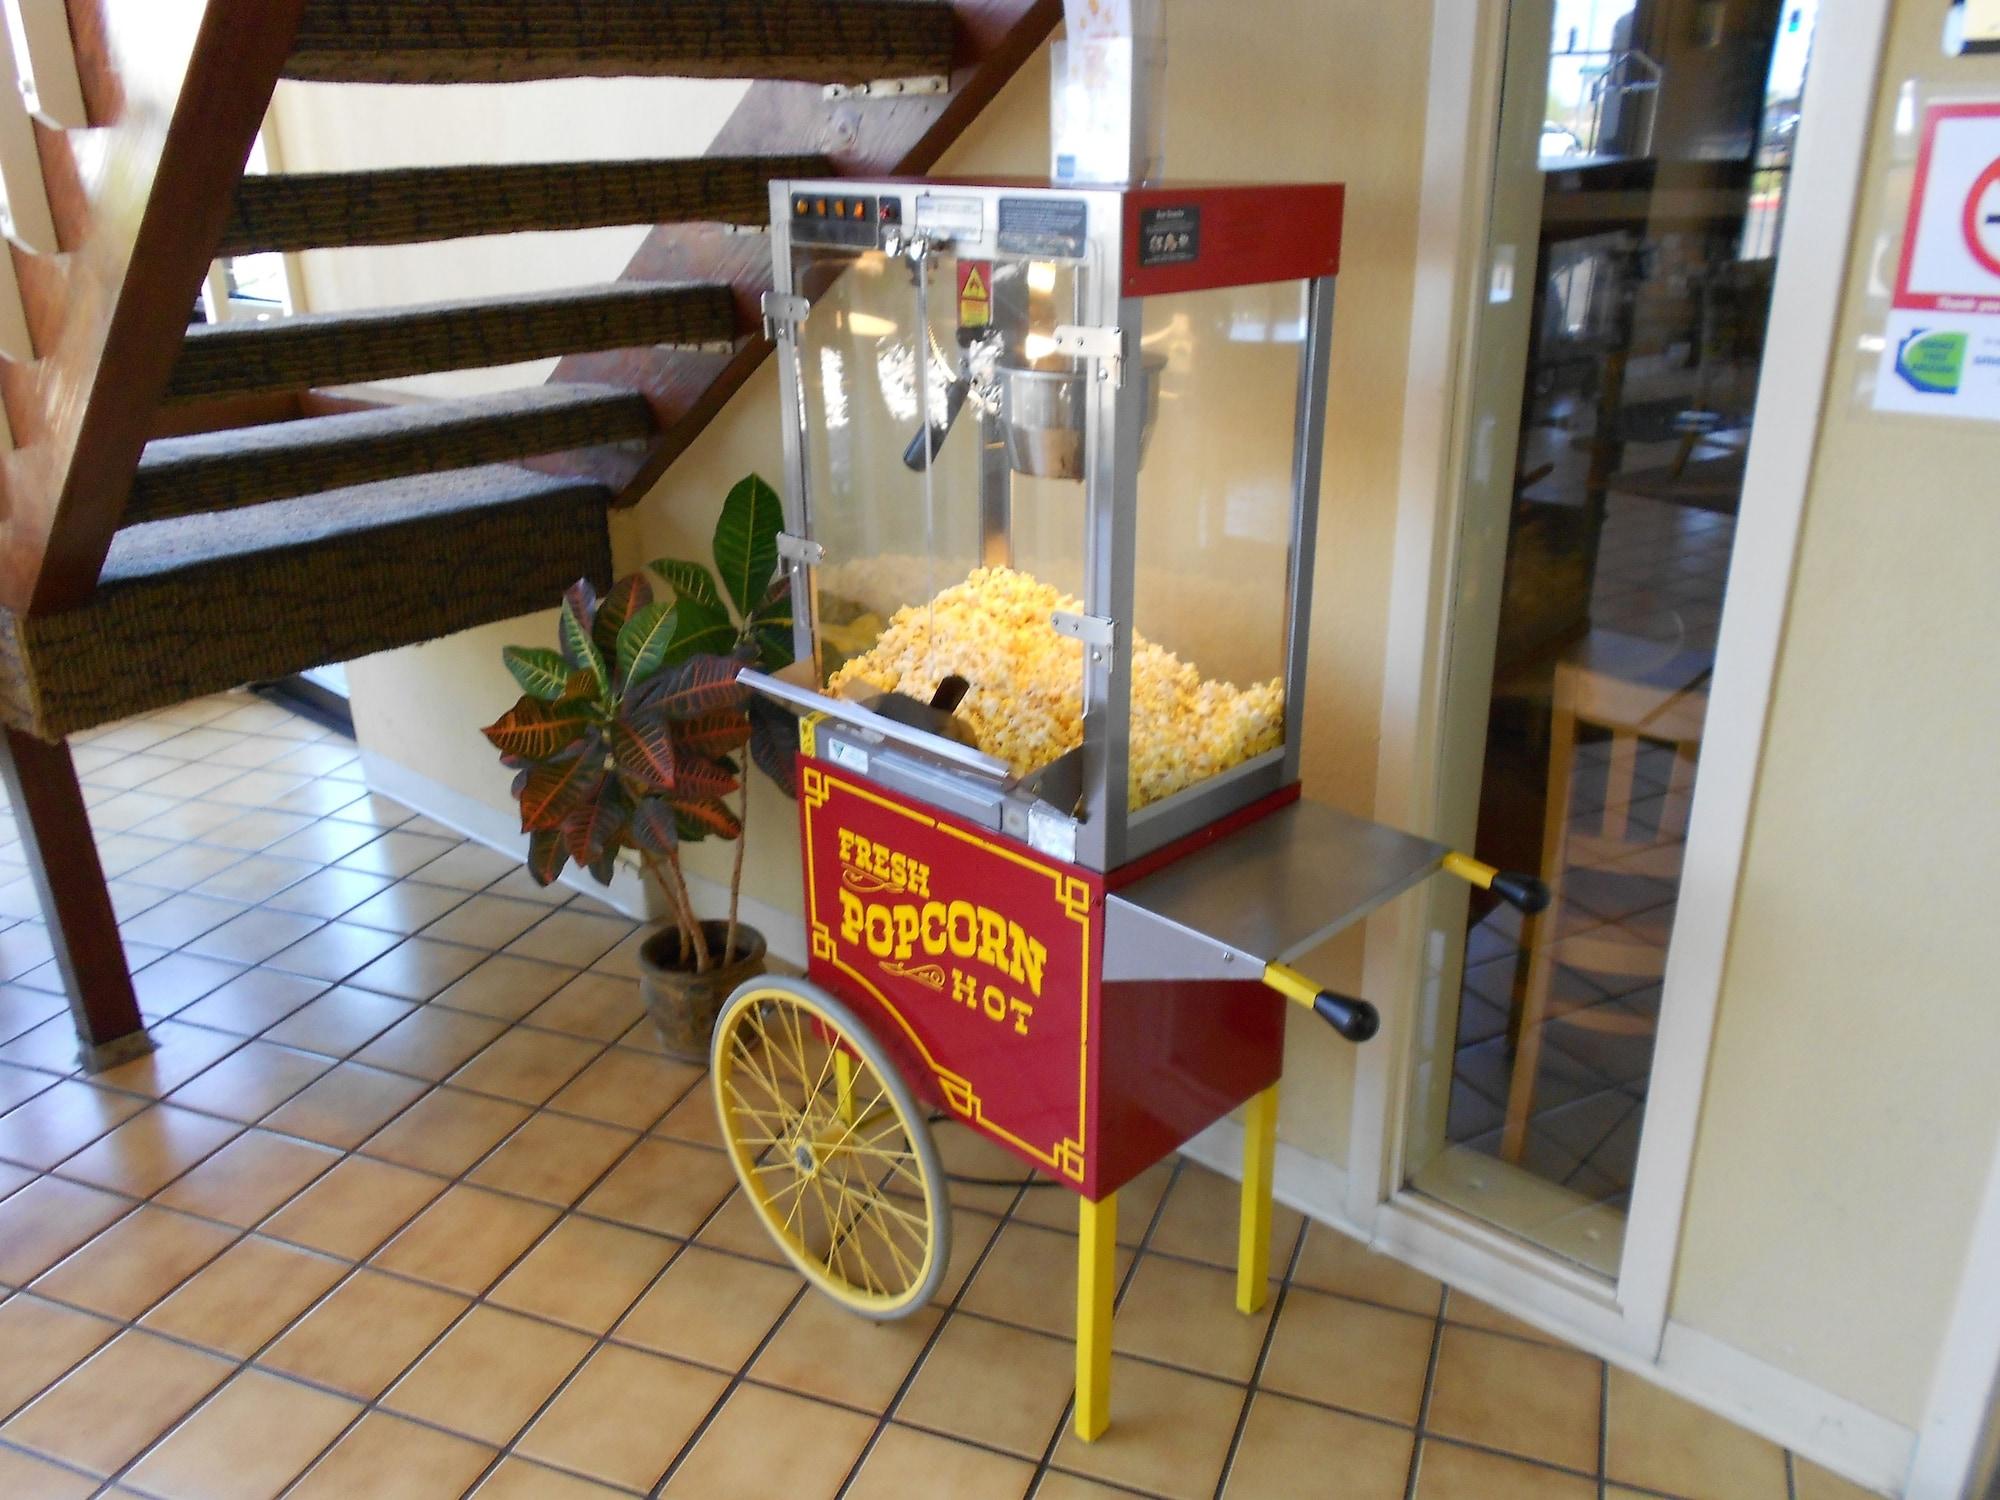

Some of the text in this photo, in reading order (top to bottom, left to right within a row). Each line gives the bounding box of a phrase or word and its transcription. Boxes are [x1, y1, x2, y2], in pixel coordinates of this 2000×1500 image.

[839, 828, 929, 898] FRESH
[840, 889, 1047, 997] POPCORN
[953, 969, 1033, 1035] HOT
